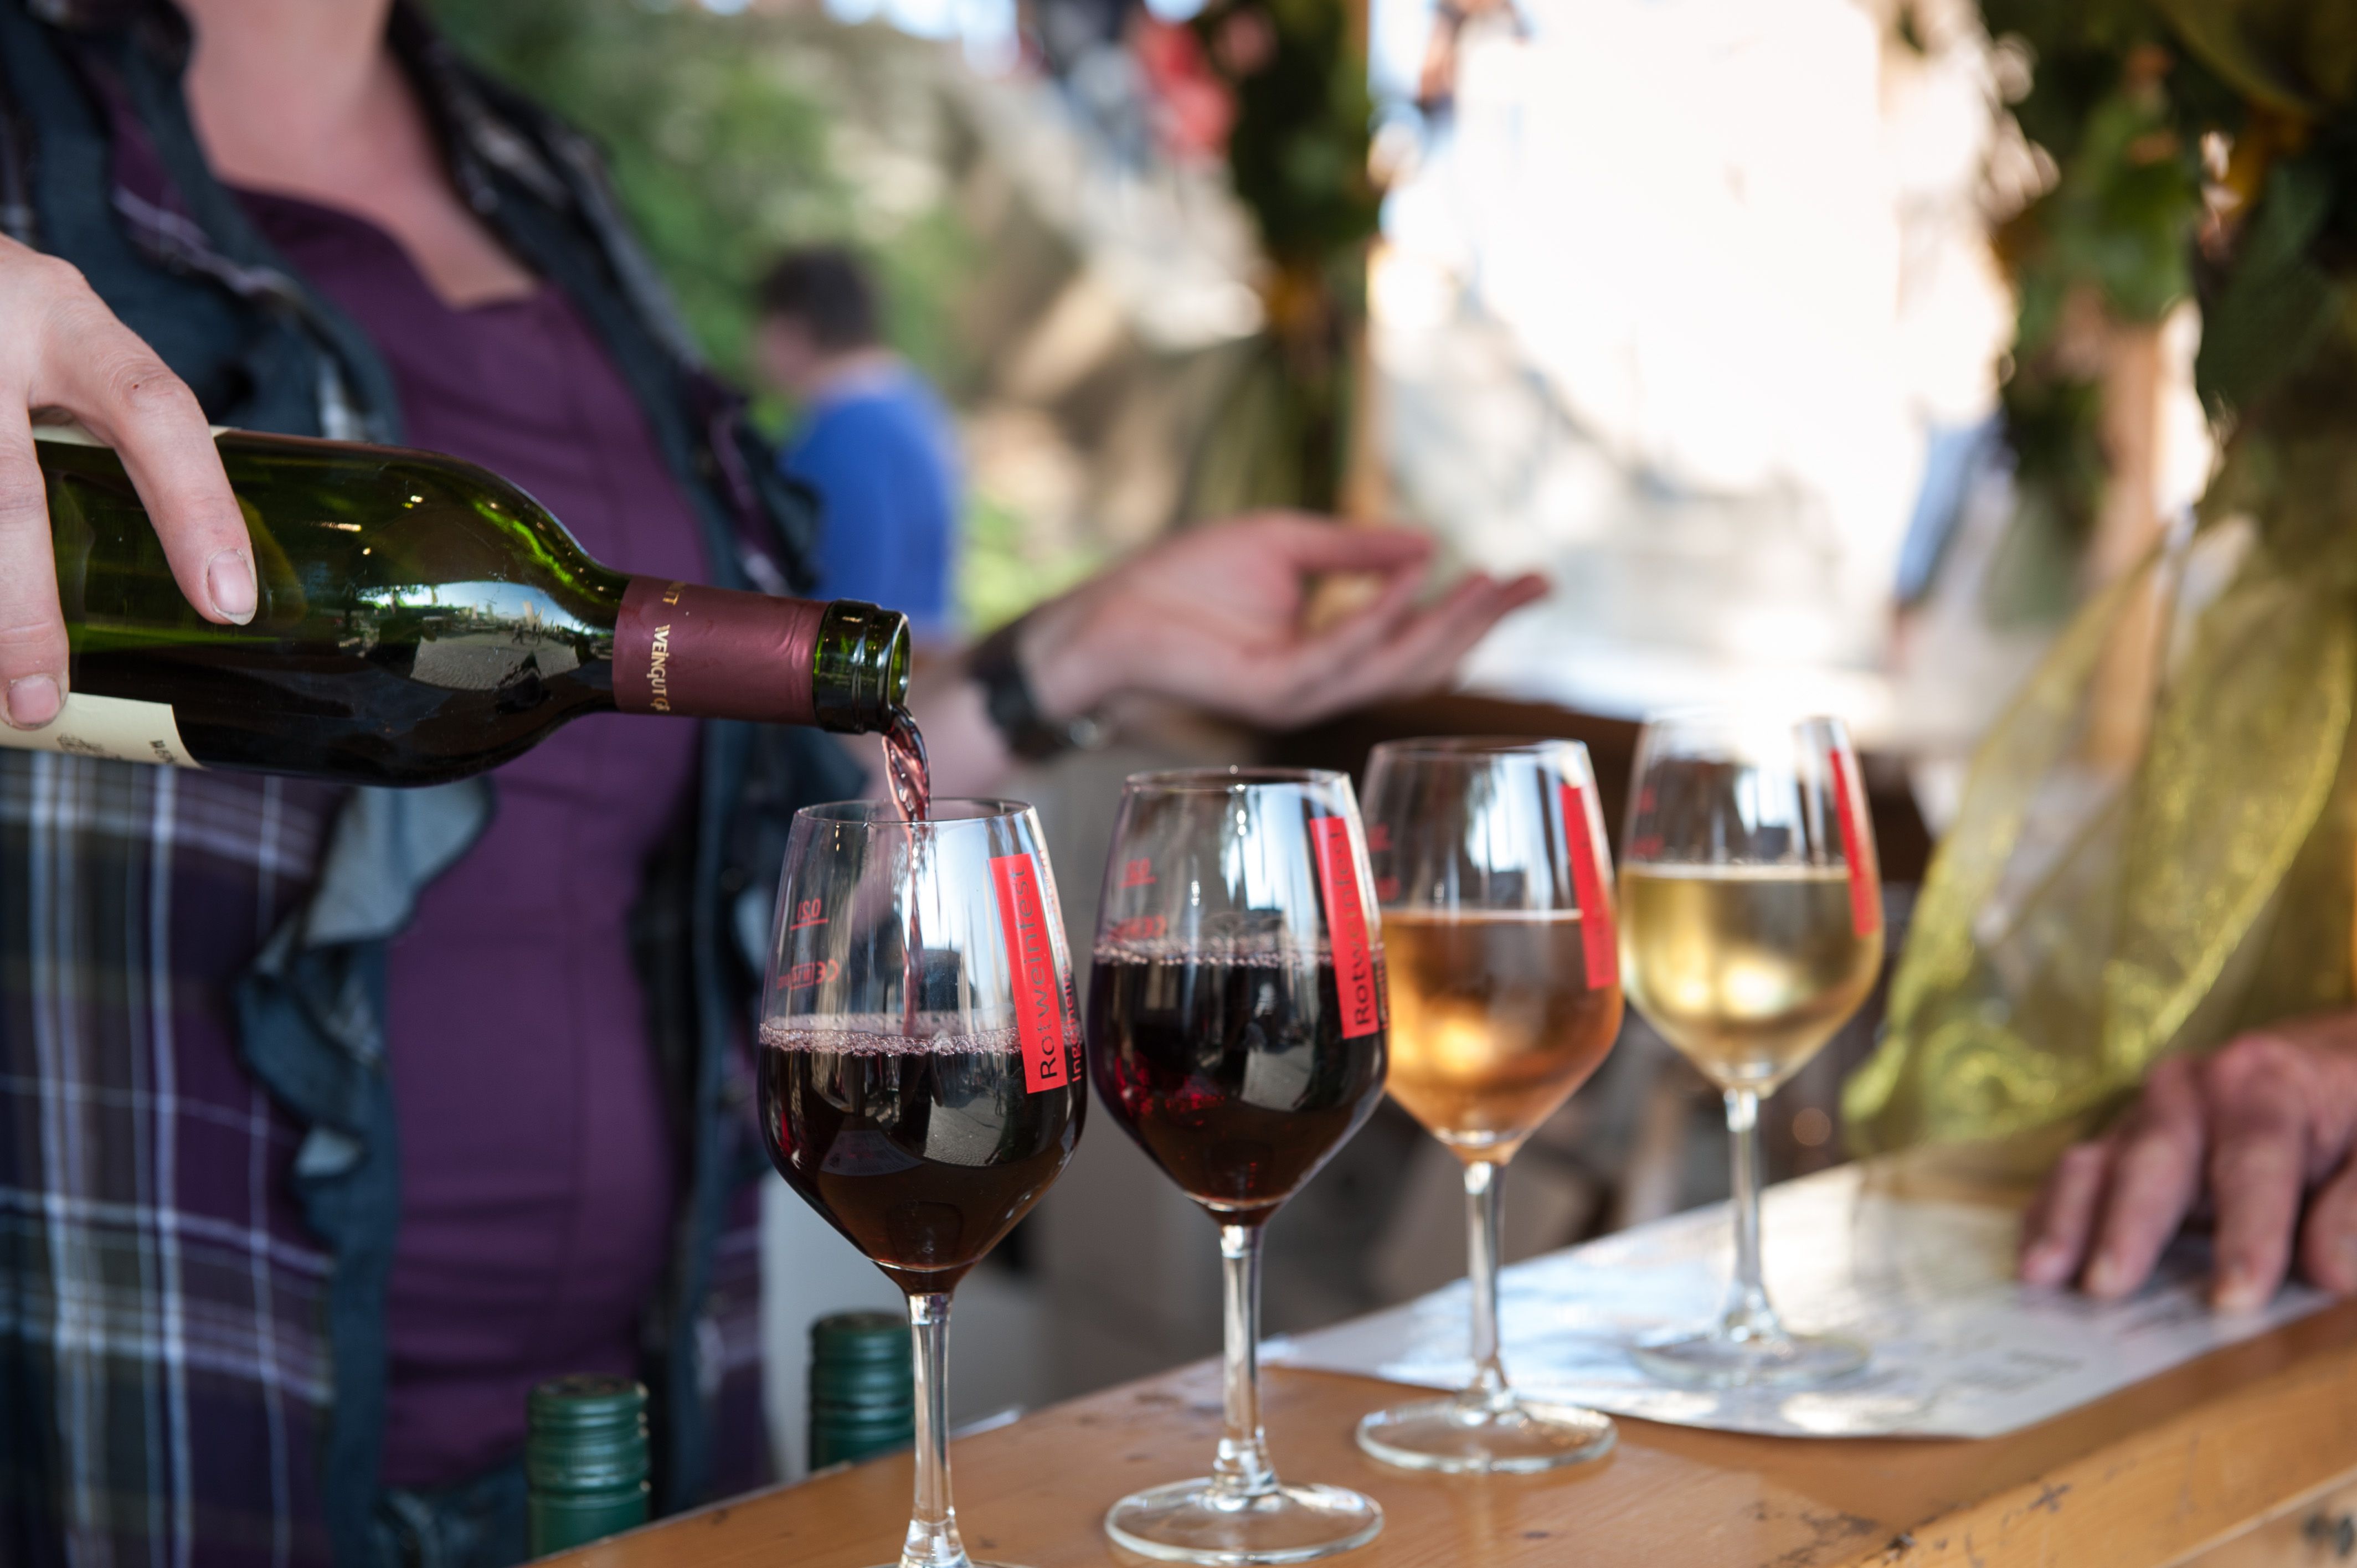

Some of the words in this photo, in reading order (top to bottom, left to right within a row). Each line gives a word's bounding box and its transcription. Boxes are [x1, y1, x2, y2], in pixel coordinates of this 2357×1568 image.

[647, 624, 670, 696] WEINGUT
[1011, 866, 1058, 1080] Rotweinfest
[1329, 829, 1371, 1025] Rotweinfest
[1062, 965, 1082, 1082] Ingelheim
